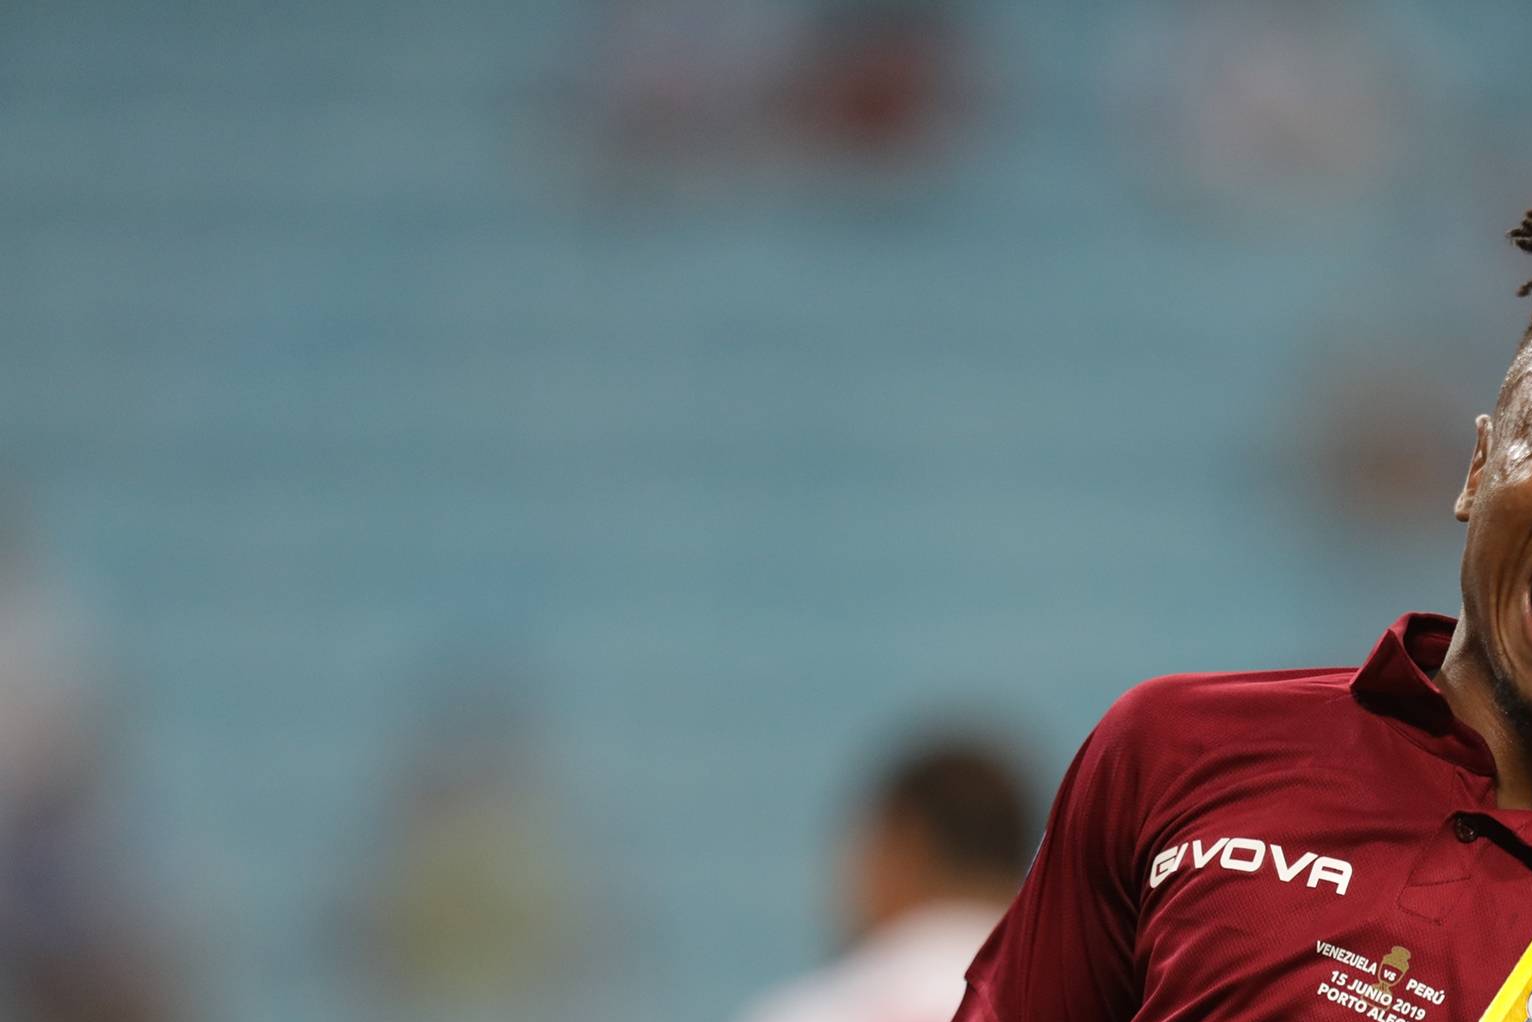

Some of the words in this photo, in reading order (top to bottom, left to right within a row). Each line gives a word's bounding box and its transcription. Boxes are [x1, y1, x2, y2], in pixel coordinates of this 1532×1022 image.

[1150, 837, 1353, 896] GIVOVA
[1316, 940, 1377, 975] VENEZUELA
[1405, 978, 1446, 1006] PERÚ
[1316, 982, 1368, 1013] PORTO
[1330, 970, 1348, 986] 15
[1347, 979, 1393, 1006] JUNIO
[1392, 998, 1426, 1021] 2019
